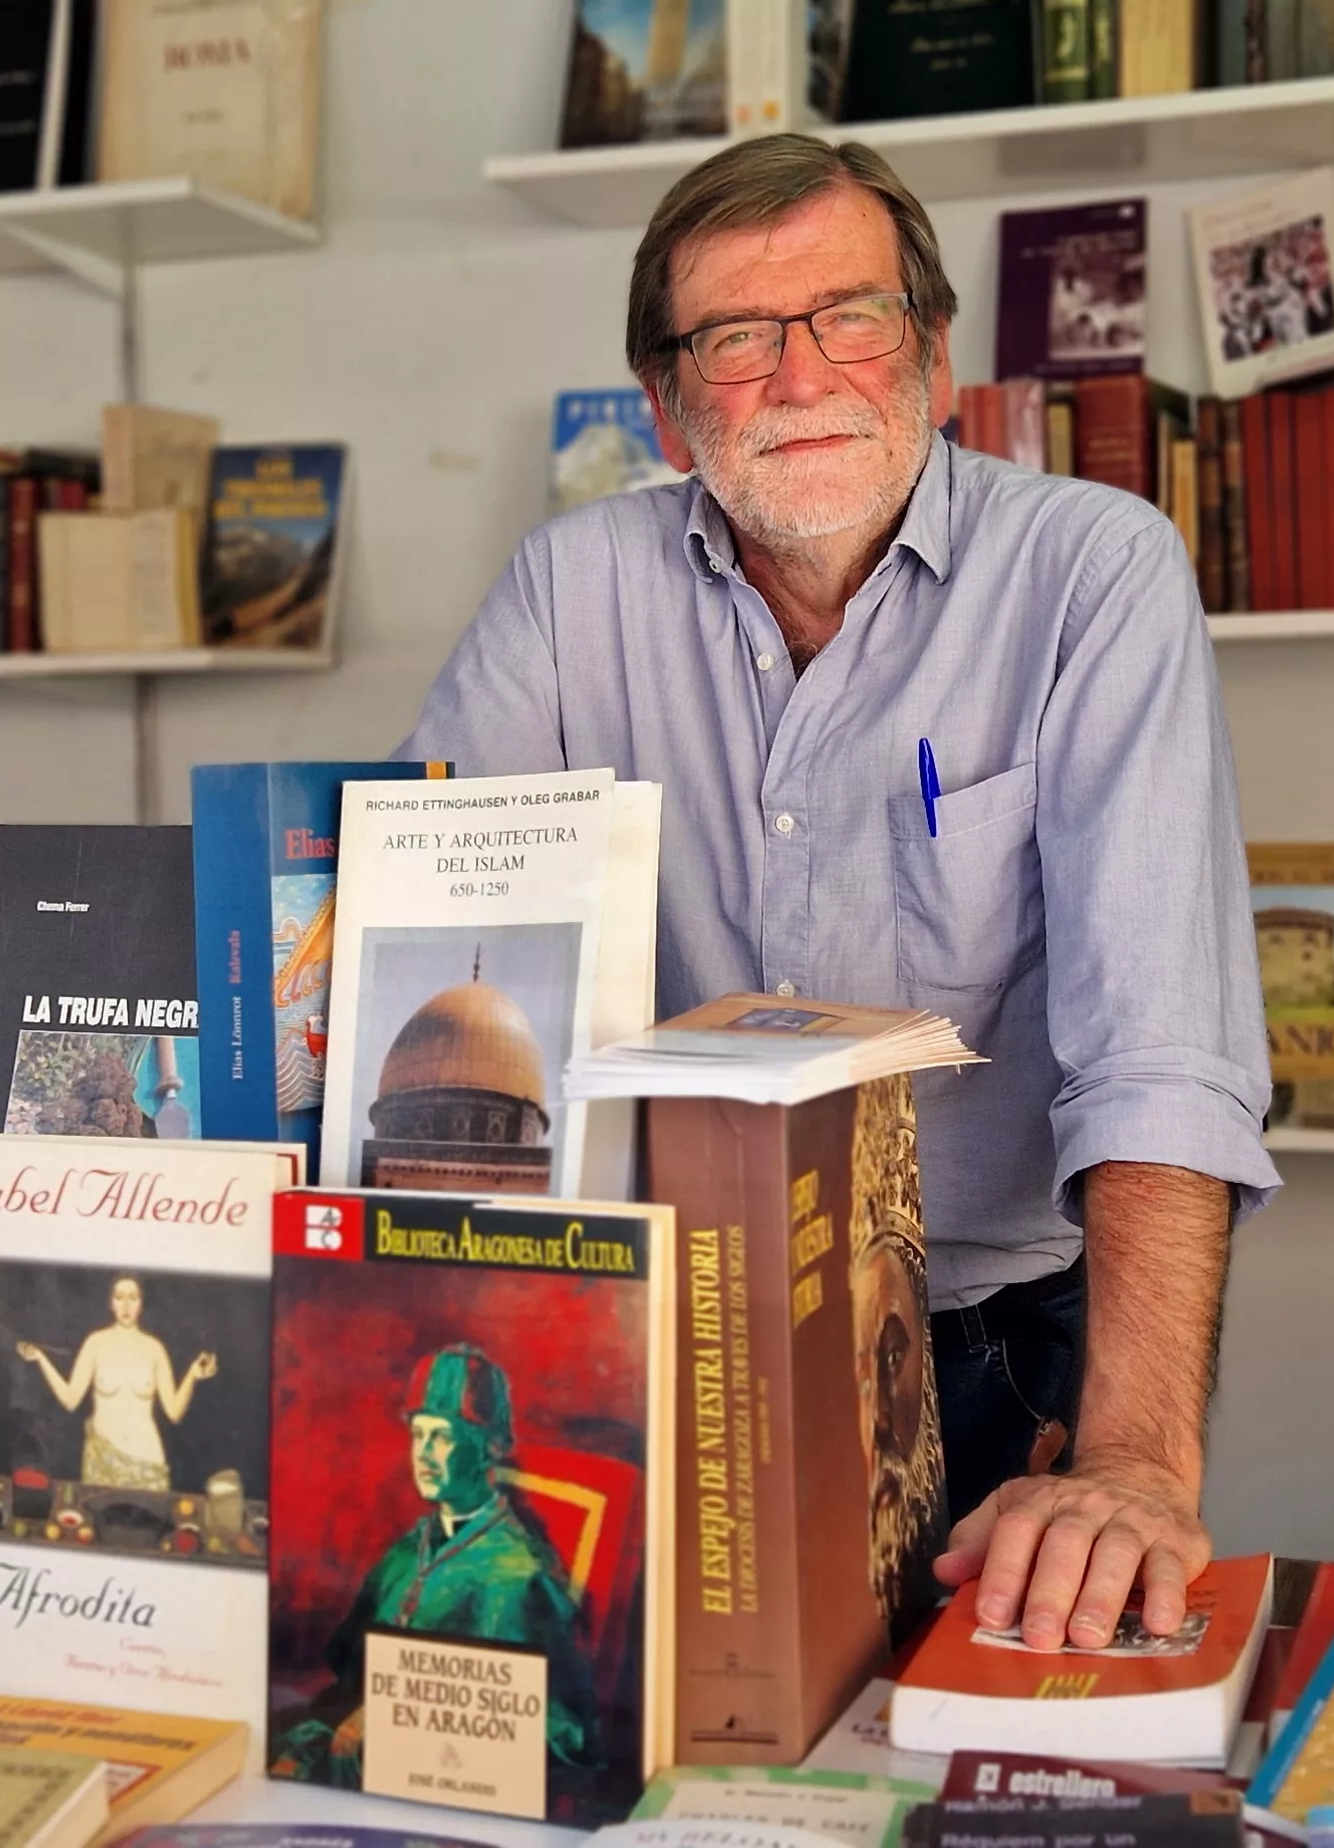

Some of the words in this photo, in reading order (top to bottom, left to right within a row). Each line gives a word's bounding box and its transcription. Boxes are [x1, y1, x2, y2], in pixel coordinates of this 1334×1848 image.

[365, 800, 420, 812] RICHARD
[422, 796, 509, 811] ETTINGHAUSEN
[510, 795, 519, 807] Y
[520, 793, 551, 806] OLEG
[552, 790, 601, 804] GRABAR
[283, 827, 336, 861] Elias
[382, 833, 429, 850] ARTE
[434, 832, 446, 849] Y
[449, 826, 578, 851] ARQUITECTURA
[436, 857, 470, 874] DEL
[474, 854, 526, 873] ISLAM
[449, 881, 510, 898] 650-1250
[226, 929, 243, 985] Kalevala
[22, 994, 51, 1024] LA
[57, 996, 130, 1027] TRUFA
[134, 998, 200, 1029] NEGR
[230, 995, 244, 1047] Lönnrot
[231, 1047, 244, 1080] Elias
[75, 1167, 251, 1228] Allende
[688, 1228, 723, 1343] HISTORIA
[693, 1347, 728, 1450] NUESTRA
[696, 1455, 729, 1493] DE
[698, 1493, 738, 1582] ESPEJO
[701, 1583, 734, 1616] EL
[397, 1648, 513, 1687] MEMORIAS
[370, 1671, 400, 1699] DE
[402, 1676, 473, 1709] MEDIO
[476, 1687, 541, 1718] SIGLO
[391, 1701, 421, 1728] EN
[973, 1762, 1002, 1794] El
[1008, 1766, 1117, 1799] estrellero
